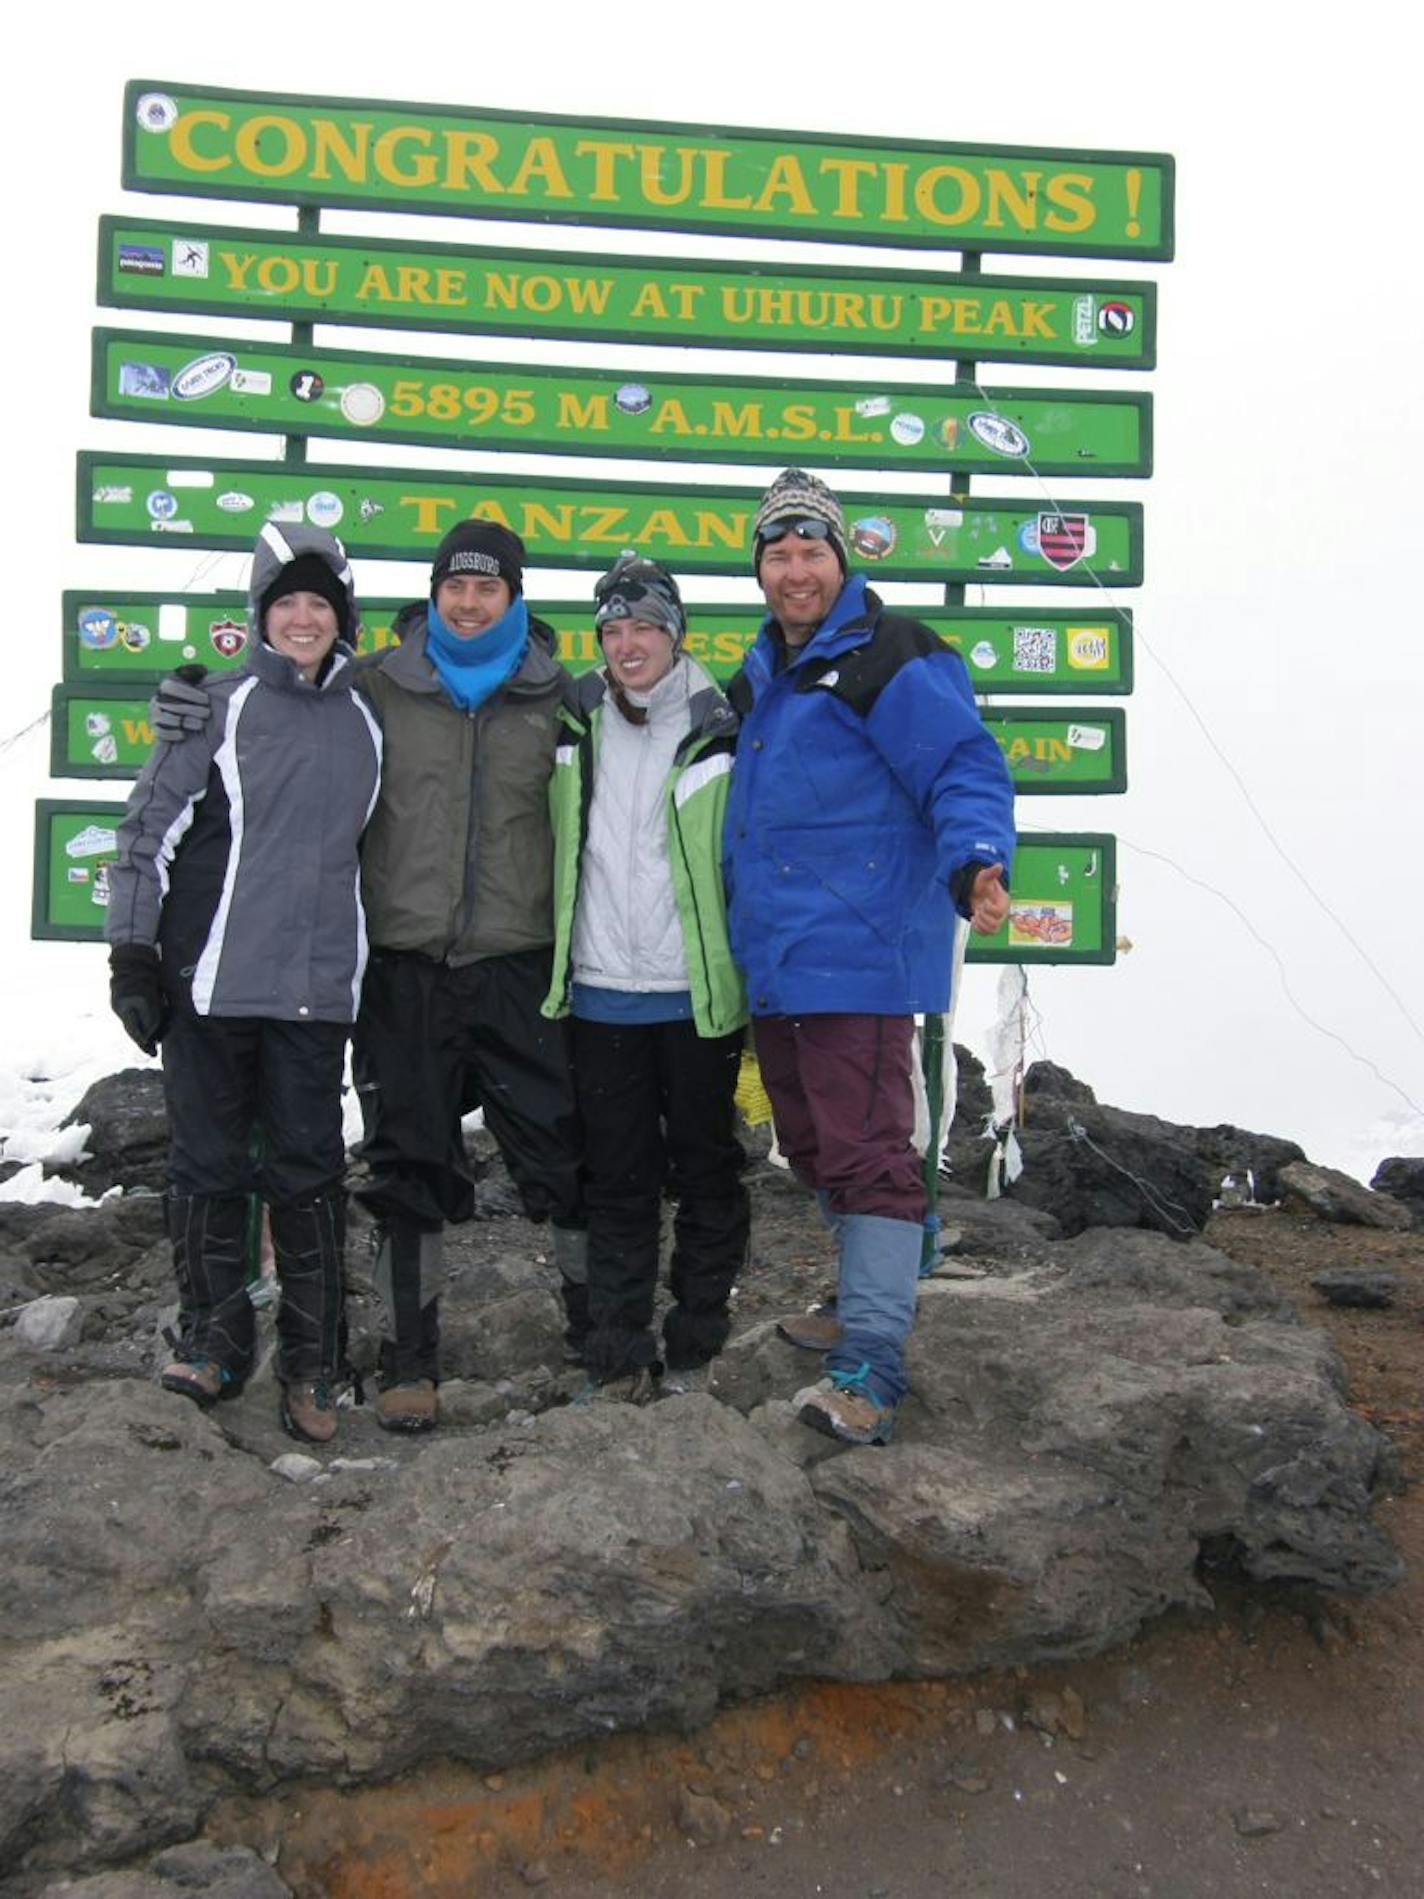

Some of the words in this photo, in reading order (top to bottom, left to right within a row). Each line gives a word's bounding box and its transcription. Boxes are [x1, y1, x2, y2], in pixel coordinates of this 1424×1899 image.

[168, 110, 1097, 233] CONGRATULATIONS
[217, 251, 339, 296] YOU
[356, 264, 468, 306] ARE
[485, 272, 614, 315] NOW
[631, 282, 705, 320] AT
[722, 286, 904, 331] UHURU
[919, 295, 1057, 339] PEAK
[390, 381, 536, 427] 5895
[558, 392, 609, 430] M
[650, 399, 885, 443] A.M.S.L.
